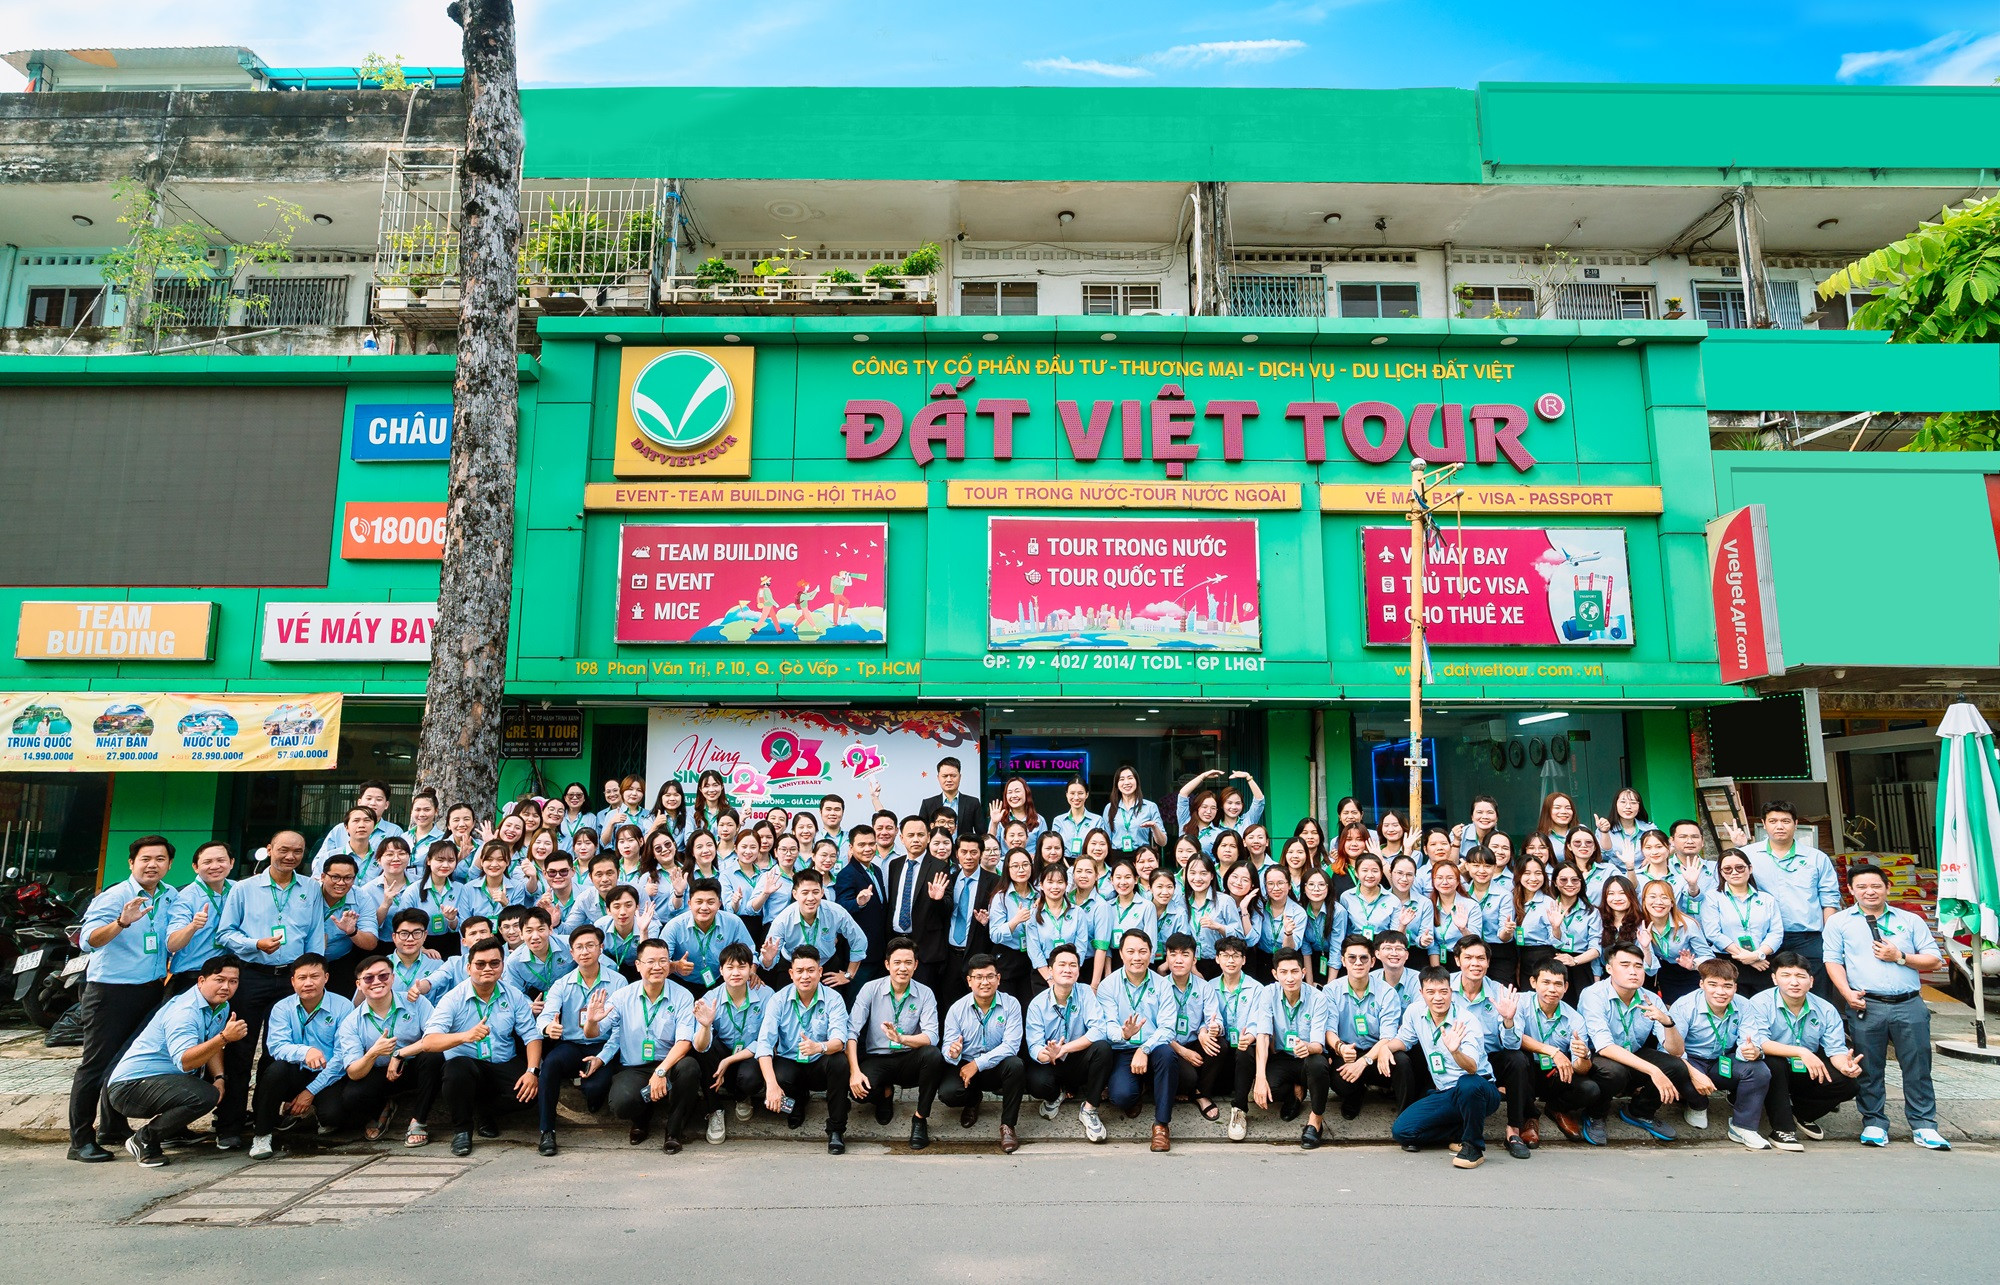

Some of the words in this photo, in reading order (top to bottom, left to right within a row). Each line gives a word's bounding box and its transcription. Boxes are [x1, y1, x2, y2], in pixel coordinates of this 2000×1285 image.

[852, 355, 908, 375] CÔNG
[913, 360, 938, 375] TY
[943, 352, 973, 375] CỔ
[978, 353, 1030, 375] PHẦN
[1035, 353, 1074, 375] ĐẦU
[1079, 359, 1107, 375] TƯ
[1119, 359, 1203, 377] THƯƠNG
[1209, 361, 1243, 380] MẠI
[1259, 361, 1304, 381] DỊCH
[1308, 362, 1335, 382] VỤ
[1352, 363, 1379, 379] DU
[1385, 362, 1427, 382] LỊCH
[1432, 358, 1468, 380] ĐẤT
[1473, 360, 1515, 383] VIỆT
[368, 411, 448, 445] CHÂU
[840, 376, 1031, 468] ĐẤT
[1056, 384, 1260, 479] VIỆT
[1285, 401, 1538, 474] TOUR
[730, 489, 805, 502] BUILDING
[817, 485, 845, 505] HỘI
[852, 485, 897, 501] THẢO
[964, 487, 1008, 500] TOUR
[1015, 487, 1073, 500] TRONG
[1182, 485, 1229, 502] NƯỚC
[1235, 485, 1286, 503] NGOÀI
[1365, 488, 1387, 504] VÉ
[1391, 488, 1413, 504] MÁ
[1478, 491, 1516, 505] VISA
[1529, 492, 1614, 506] PASSPORT
[657, 543, 709, 562] TEAM
[713, 543, 799, 562] BUILDING
[1047, 538, 1098, 556] TOUR
[1102, 538, 1168, 557] TRONG
[1172, 535, 1227, 557] NƯỚC
[1429, 543, 1469, 565] MÁY
[1474, 547, 1509, 565] BAY
[655, 573, 715, 591] EVENT
[1047, 568, 1098, 586] TOUR
[1103, 564, 1157, 589] QUỐC
[1160, 564, 1187, 587] TẾ
[1444, 577, 1482, 599] TỤC
[1481, 577, 1530, 595] VISA
[76, 605, 152, 629] TEAM
[654, 602, 701, 620] MICE
[1447, 602, 1497, 624] THUÊ
[1501, 606, 1525, 624] XE
[277, 612, 311, 644] VÉ
[320, 612, 382, 644] MÁY
[46, 630, 176, 655] BUILDING
[575, 661, 599, 675] 198
[607, 661, 647, 675] Phan
[652, 661, 683, 675] Văn
[689, 661, 711, 678] Trị,
[755, 661, 775, 675] Q.
[779, 660, 804, 675] Gò
[807, 659, 839, 678] Vấp
[857, 661, 921, 678] Tp.HCM
[983, 654, 1010, 669] GP:
[1017, 655, 1035, 670] 79
[1050, 654, 1088, 670] 402/
[1093, 654, 1137, 671] 2014/
[1142, 656, 1183, 671] TCDL
[1197, 656, 1220, 671] GP
[1224, 656, 1267, 672] LHQT
[7, 736, 41, 748] TRUNG
[43, 732, 73, 749] QUỐC
[95, 736, 123, 750] NHẬT
[126, 733, 148, 748] BẢN
[183, 734, 213, 748] NƯỚC
[216, 735, 231, 748] ÚC
[506, 725, 545, 739] GREEN
[548, 725, 579, 739] TOUR
[23, 752, 74, 761] 14.990.000đ
[106, 751, 159, 760] 27.900.000đ
[191, 751, 244, 760] 28.990.000đ
[673, 733, 750, 776] Mừng
[1024, 759, 1047, 770] VIET
[1050, 759, 1080, 770] TOUR
[777, 780, 823, 790] ANNIVERSARY
